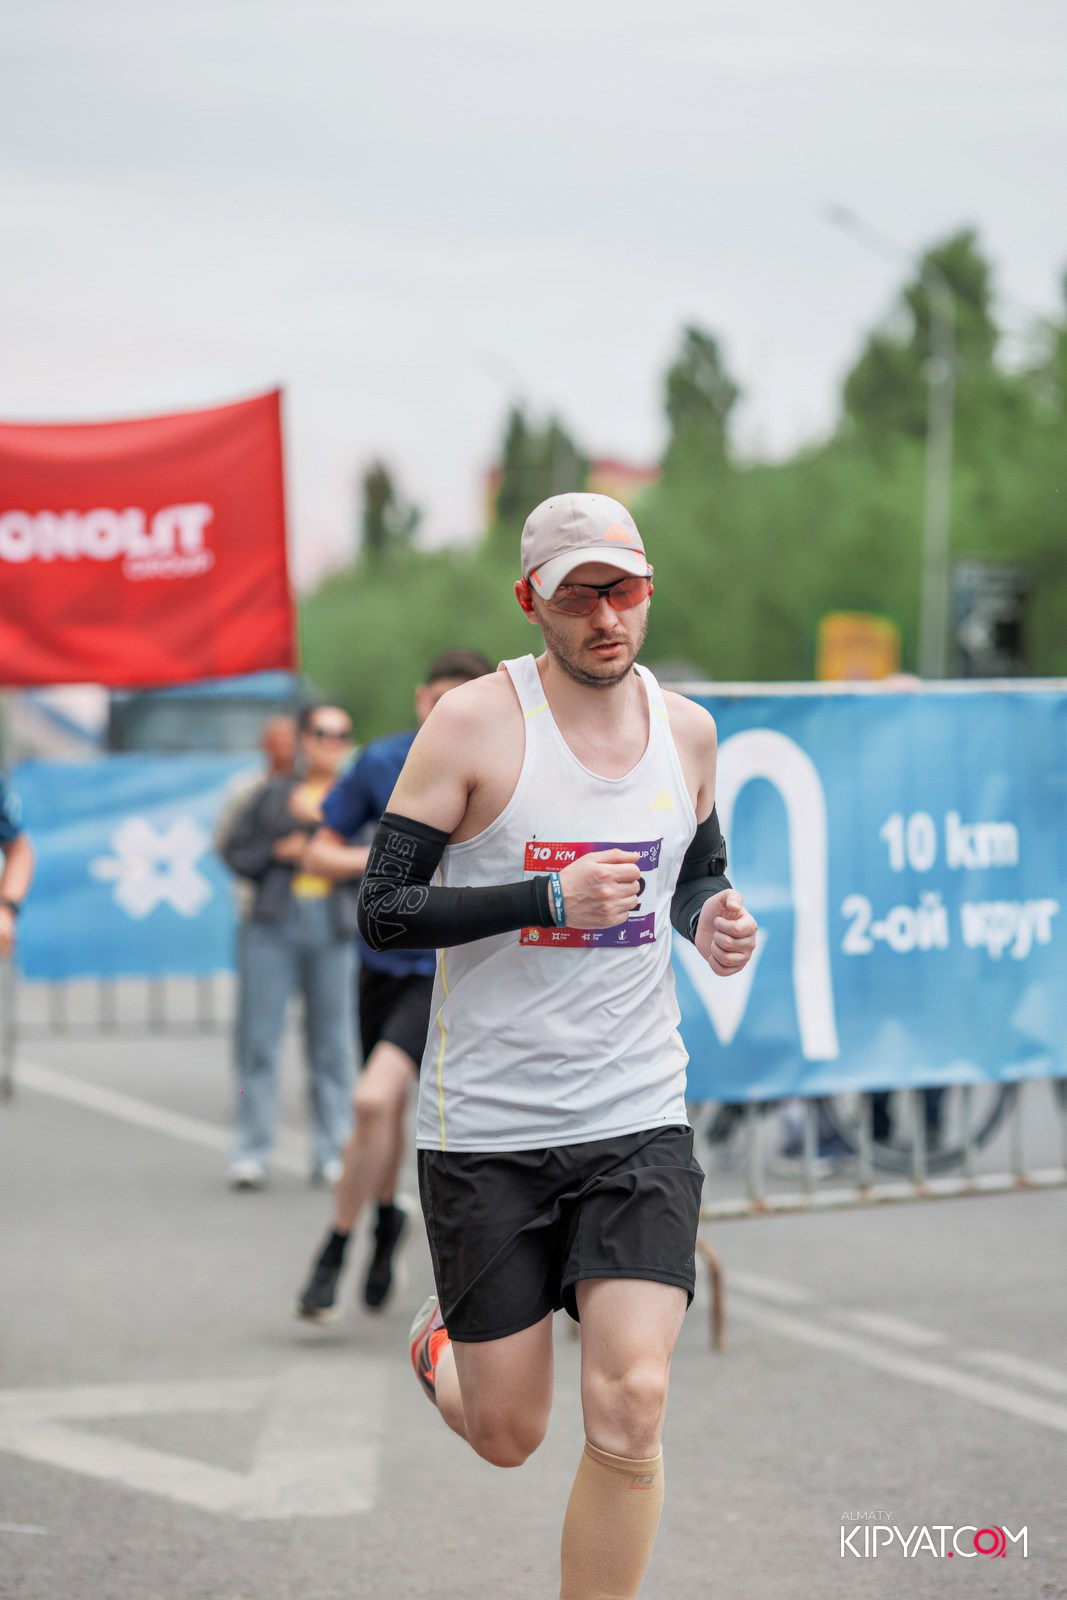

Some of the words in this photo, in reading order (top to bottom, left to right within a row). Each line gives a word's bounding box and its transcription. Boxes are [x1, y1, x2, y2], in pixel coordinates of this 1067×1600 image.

[533, 847, 551, 860] 10
[880, 811, 936, 872] 10
[945, 810, 1018, 870] km
[841, 890, 949, 955] 2-ой
[960, 898, 1060, 960] круг
